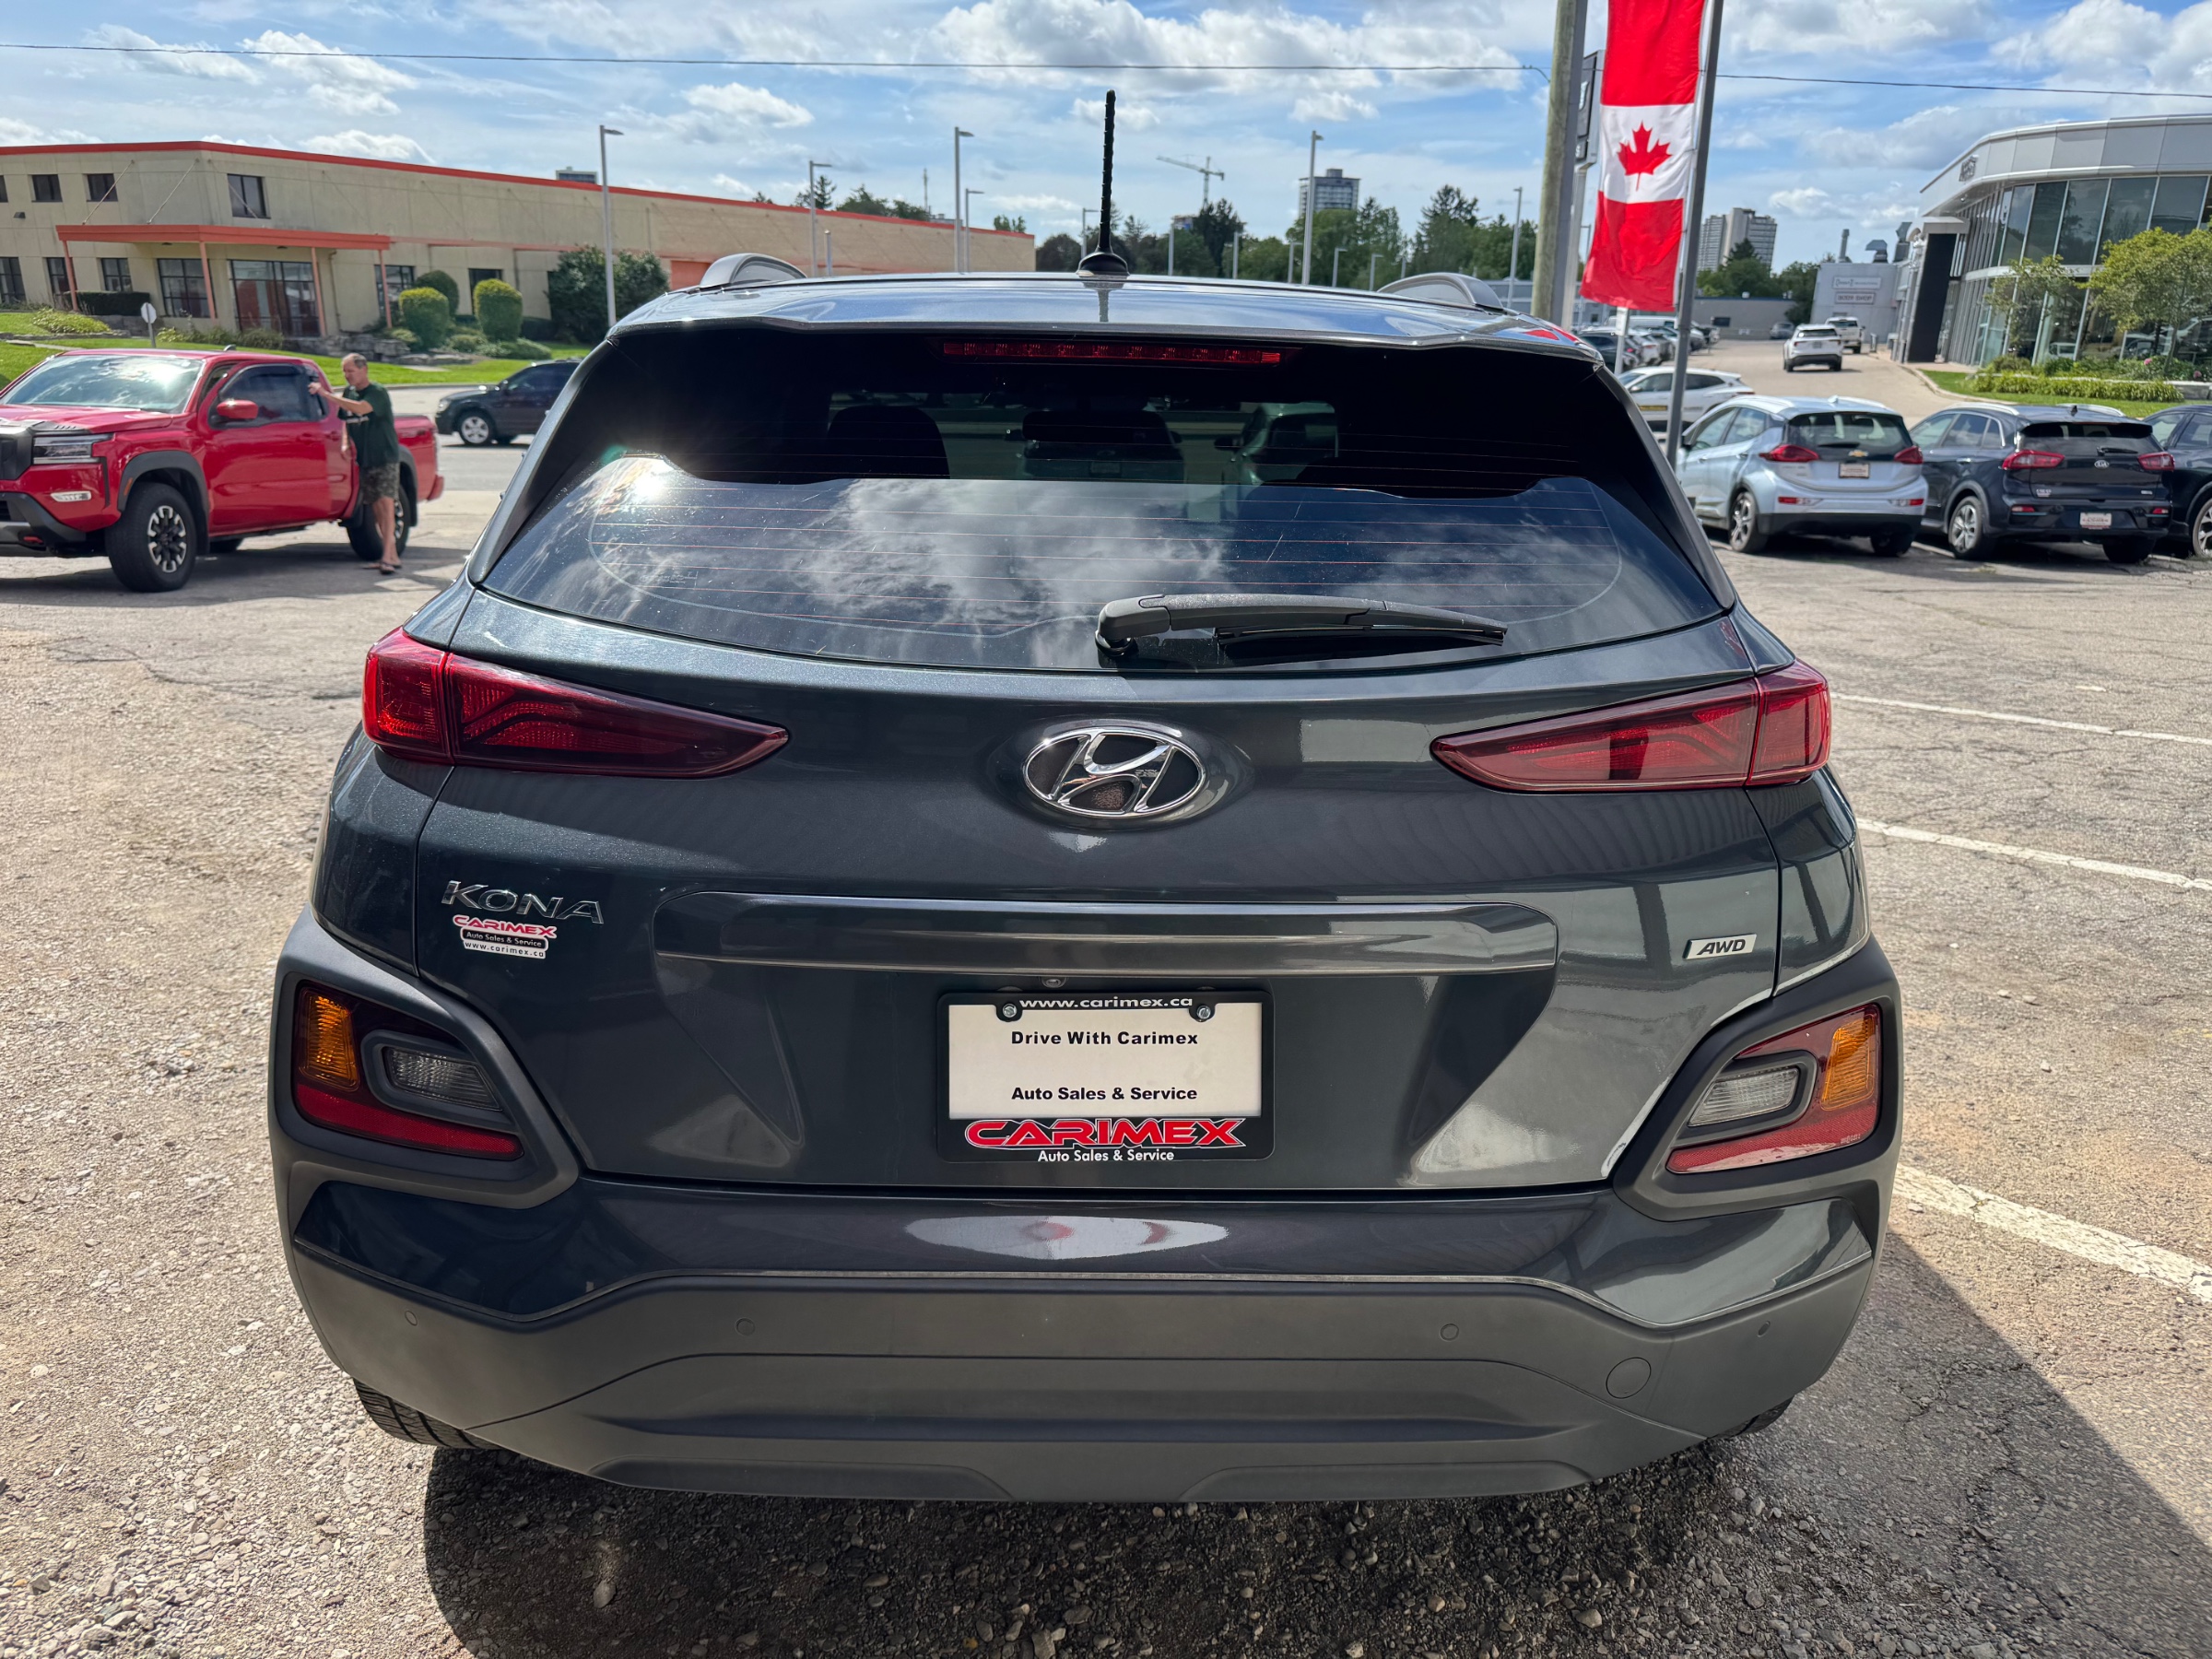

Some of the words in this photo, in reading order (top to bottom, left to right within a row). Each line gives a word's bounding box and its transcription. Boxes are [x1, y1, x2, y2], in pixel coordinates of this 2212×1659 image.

[441, 880, 604, 924] KONA
[453, 916, 555, 936] CARIMEX
[466, 931, 483, 940] Auto
[485, 934, 505, 943] Sales
[514, 938, 542, 947] Service
[1697, 939, 1746, 955] AWD
[465, 941, 544, 958] www.carimex.ca
[1019, 996, 1194, 1008] www.carimex.ca
[1011, 1031, 1062, 1045] Drive
[1067, 1031, 1112, 1045] With
[1117, 1031, 1198, 1045] Carimex
[1011, 1088, 1053, 1100] Auto
[1058, 1087, 1106, 1100] Sales
[1112, 1088, 1124, 1100] &
[1130, 1087, 1198, 1100] Service
[965, 1118, 1246, 1148] CARIMEX
[1037, 1149, 1069, 1161] Auto
[1074, 1150, 1109, 1162] Sales
[1113, 1150, 1124, 1161] &
[1127, 1149, 1174, 1161] Service
